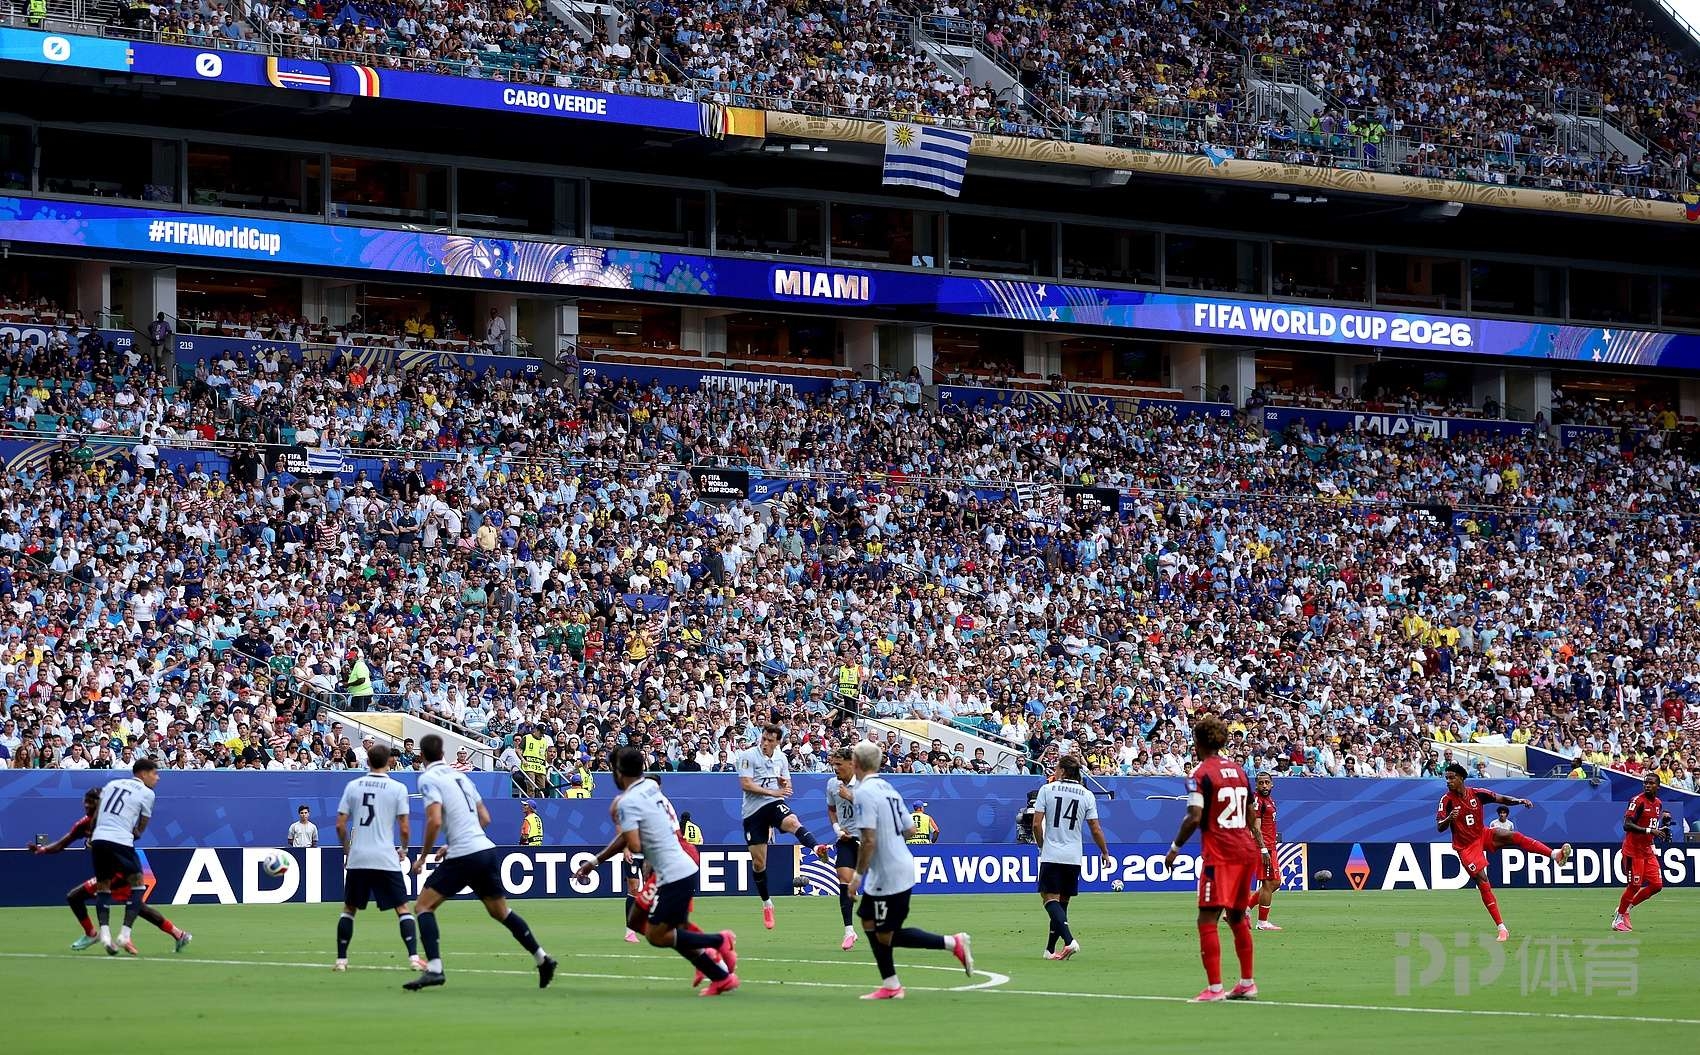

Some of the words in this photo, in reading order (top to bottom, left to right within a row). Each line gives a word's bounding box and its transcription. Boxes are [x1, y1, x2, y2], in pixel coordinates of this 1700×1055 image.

[503, 88, 550, 109] CABO
[553, 94, 607, 115] VERDE
[149, 220, 281, 256] #FIFAWorldCup
[775, 269, 869, 301] MIAMI
[1194, 303, 1247, 330] FIFA
[1250, 308, 1337, 337] WORLD
[1340, 315, 1388, 340] CUP
[1390, 320, 1472, 347] 2026
[117, 338, 131, 347] 218
[180, 341, 193, 350] 219
[1220, 409, 1231, 417] 221
[1267, 412, 1278, 420] 222
[1122, 502, 1133, 511] 121
[103, 786, 132, 816] 16
[359, 792, 376, 827] 5
[1053, 796, 1080, 831] 14
[1217, 786, 1249, 829] 20
[1465, 813, 1475, 826] 6
[171, 847, 322, 905] ADI
[951, 855, 1040, 883] WORL
[1080, 855, 1118, 882] UP
[1122, 855, 1204, 882] 202
[874, 900, 889, 921] 13
